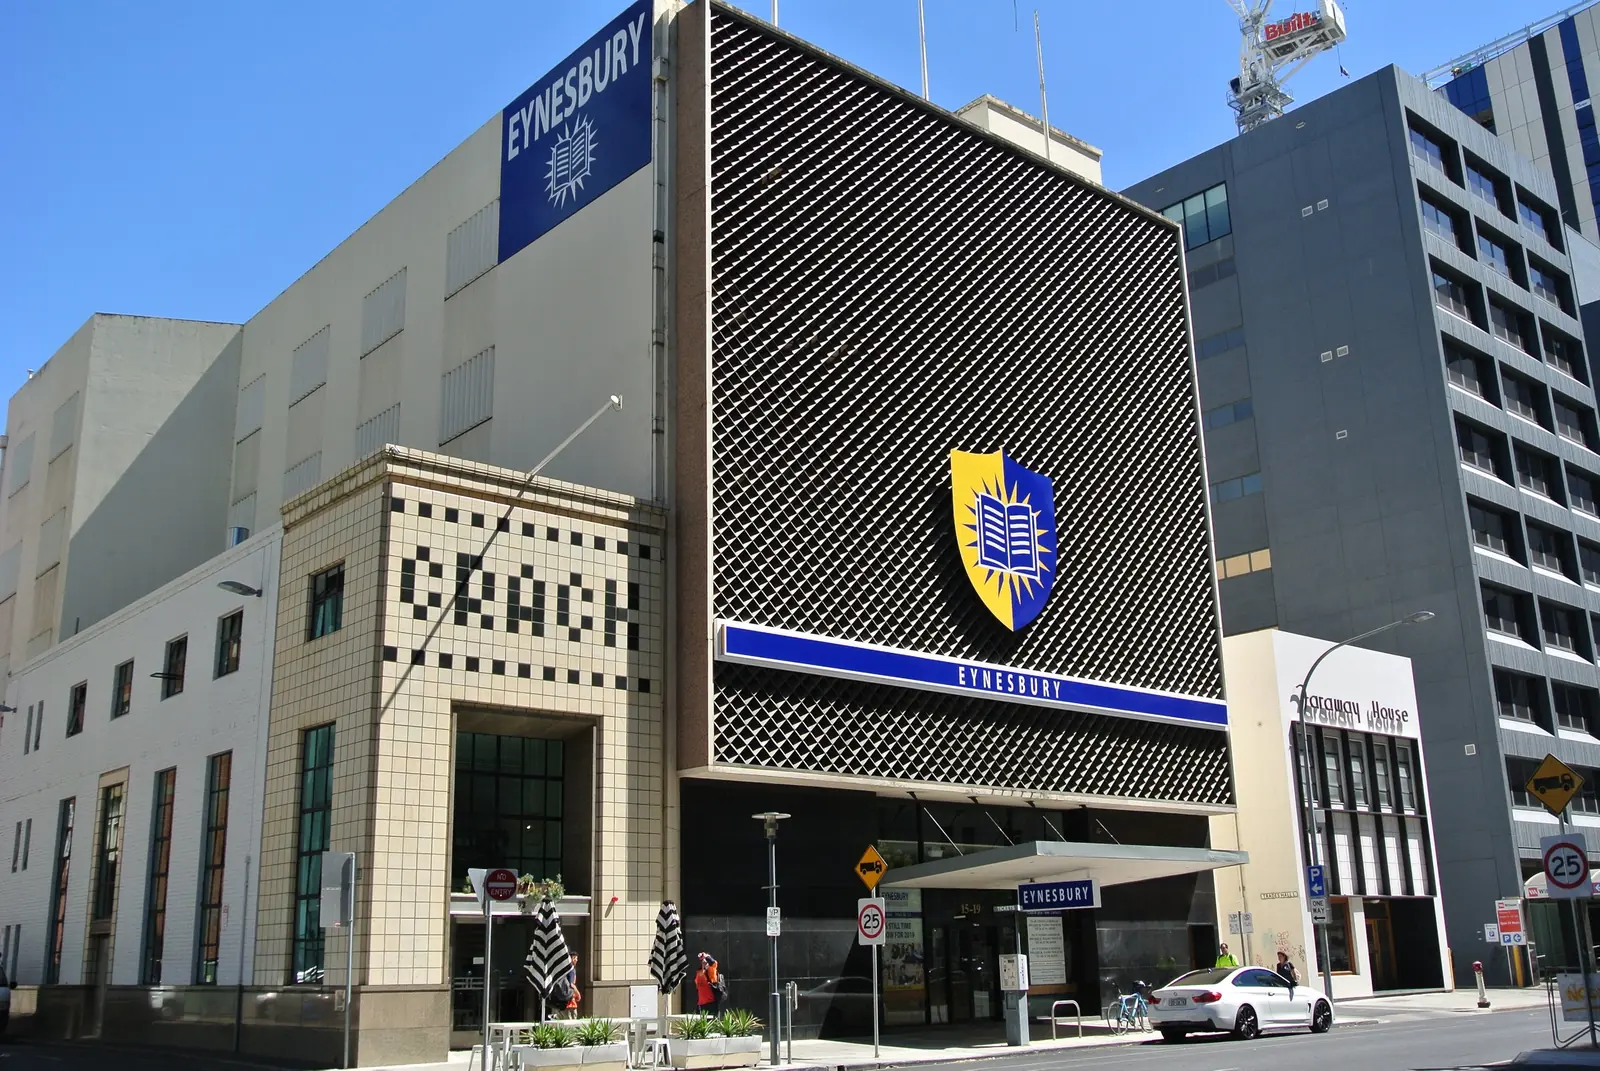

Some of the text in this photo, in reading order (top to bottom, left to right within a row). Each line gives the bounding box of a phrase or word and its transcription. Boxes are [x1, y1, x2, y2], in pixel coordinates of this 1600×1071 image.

[507, 12, 646, 162] EYNESBURY
[958, 666, 1061, 699] EYNESBURY
[1372, 700, 1409, 723] House
[1551, 854, 1581, 877] 25
[1310, 868, 1320, 882] P
[490, 888, 512, 896] ENTRY
[1023, 886, 1090, 904] EYNESBURY
[961, 904, 981, 914] 15-19
[863, 913, 880, 929] 25
